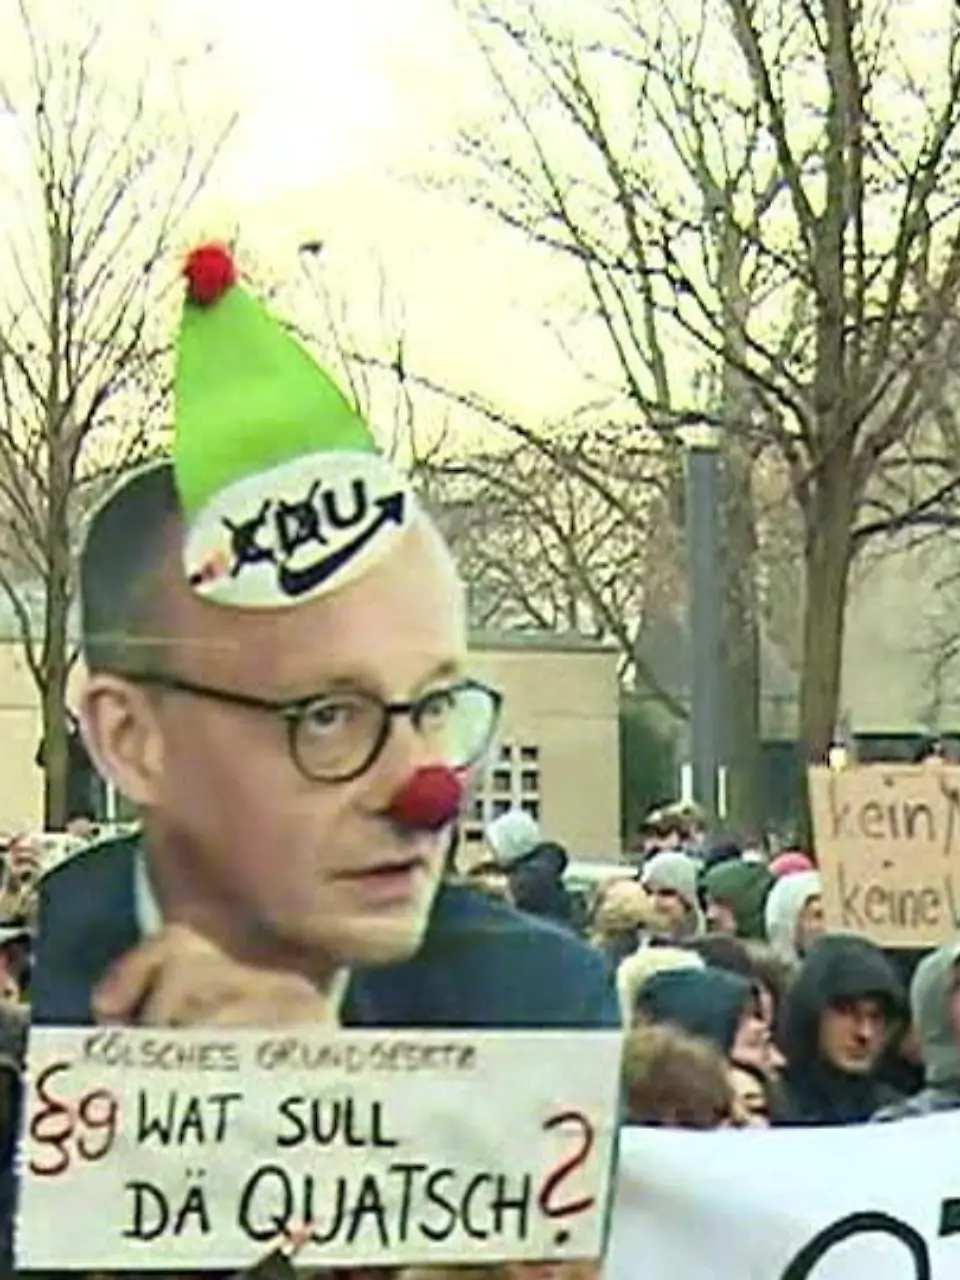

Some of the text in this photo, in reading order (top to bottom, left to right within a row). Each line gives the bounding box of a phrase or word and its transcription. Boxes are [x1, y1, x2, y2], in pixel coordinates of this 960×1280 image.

[828, 776, 937, 842] kein
[837, 859, 940, 930] keine
[136, 1081, 243, 1147] WAT
[277, 1095, 401, 1149] SULL
[122, 1169, 211, 1242] DÄ
